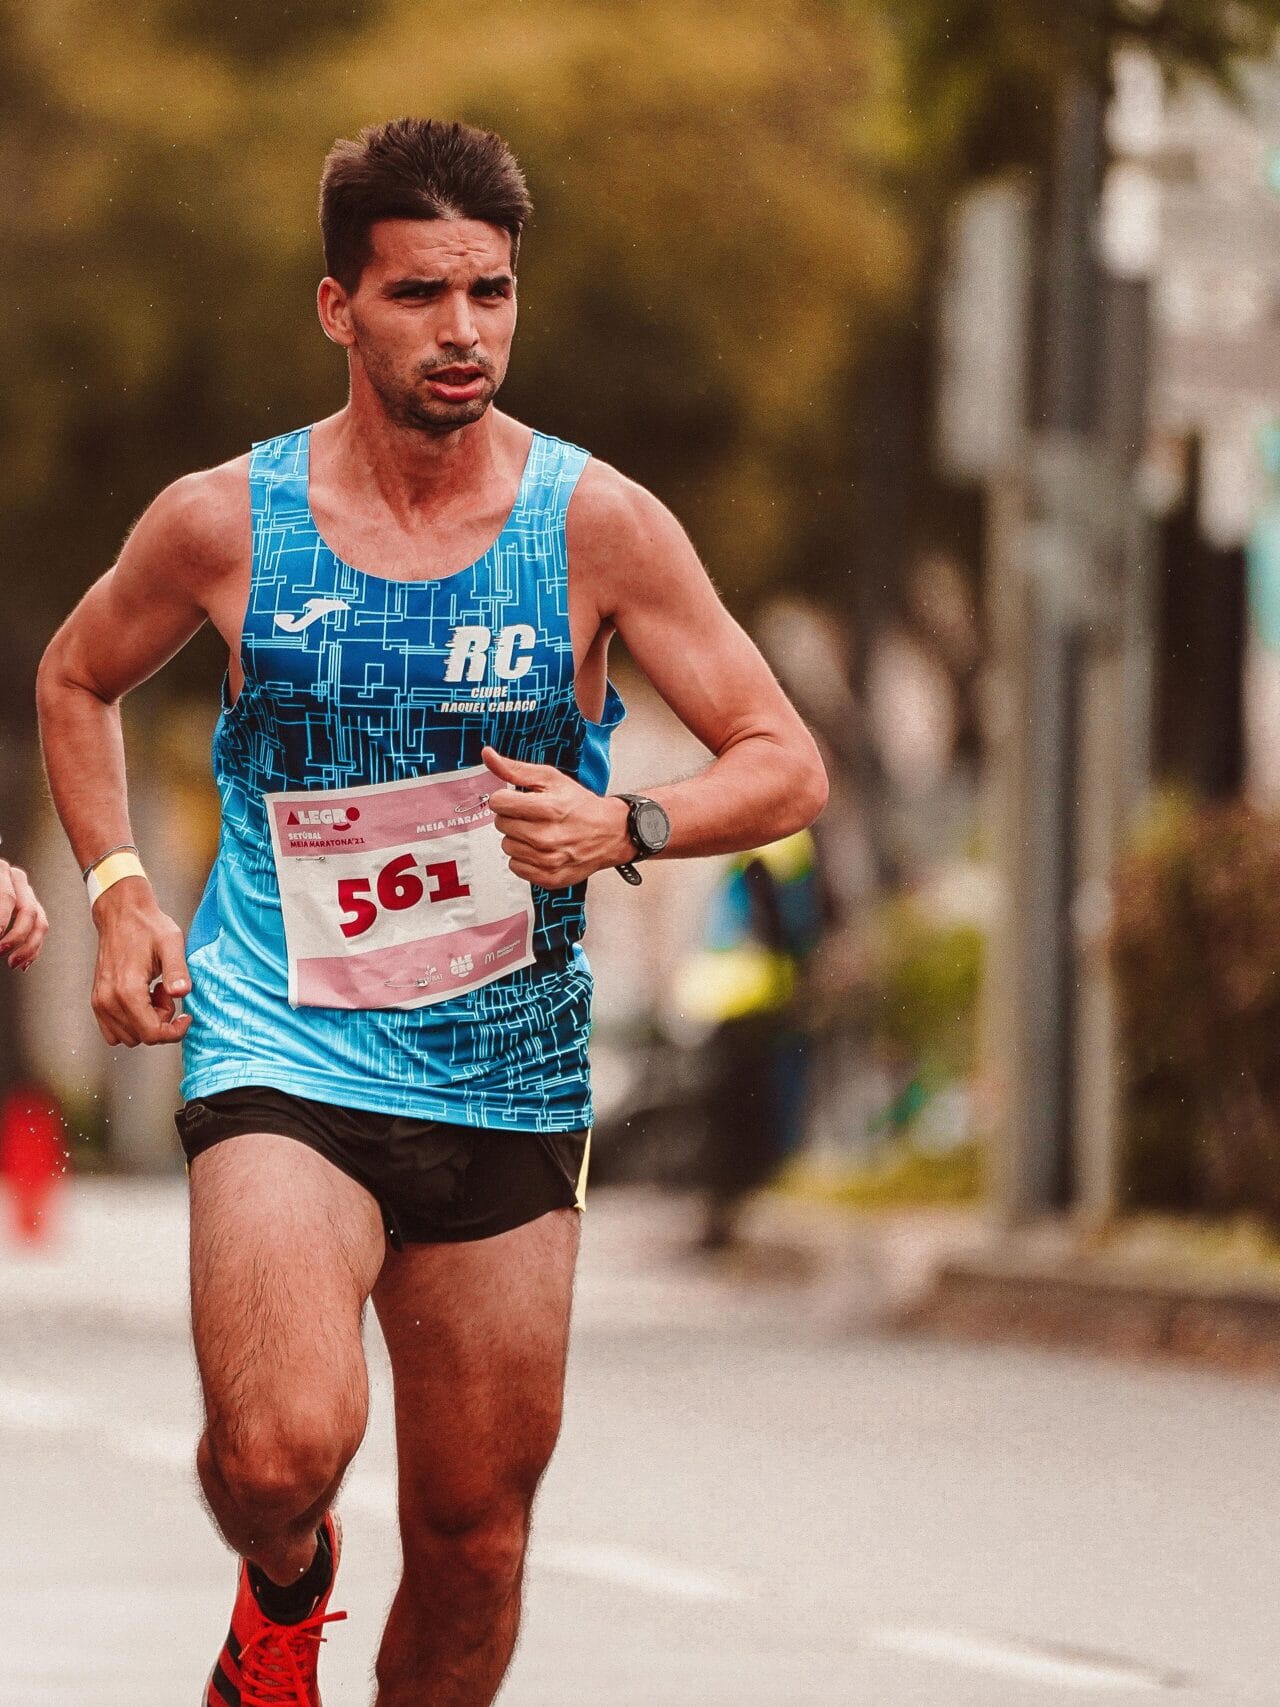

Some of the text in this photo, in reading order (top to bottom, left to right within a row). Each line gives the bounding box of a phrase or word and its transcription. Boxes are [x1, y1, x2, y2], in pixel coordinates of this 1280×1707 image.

[443, 624, 536, 682] RC
[471, 686, 508, 698] CLUBE
[441, 702, 486, 713] RAQUEL
[417, 822, 445, 833] MEIA
[291, 840, 308, 848] MEIA
[338, 853, 470, 938] 561
